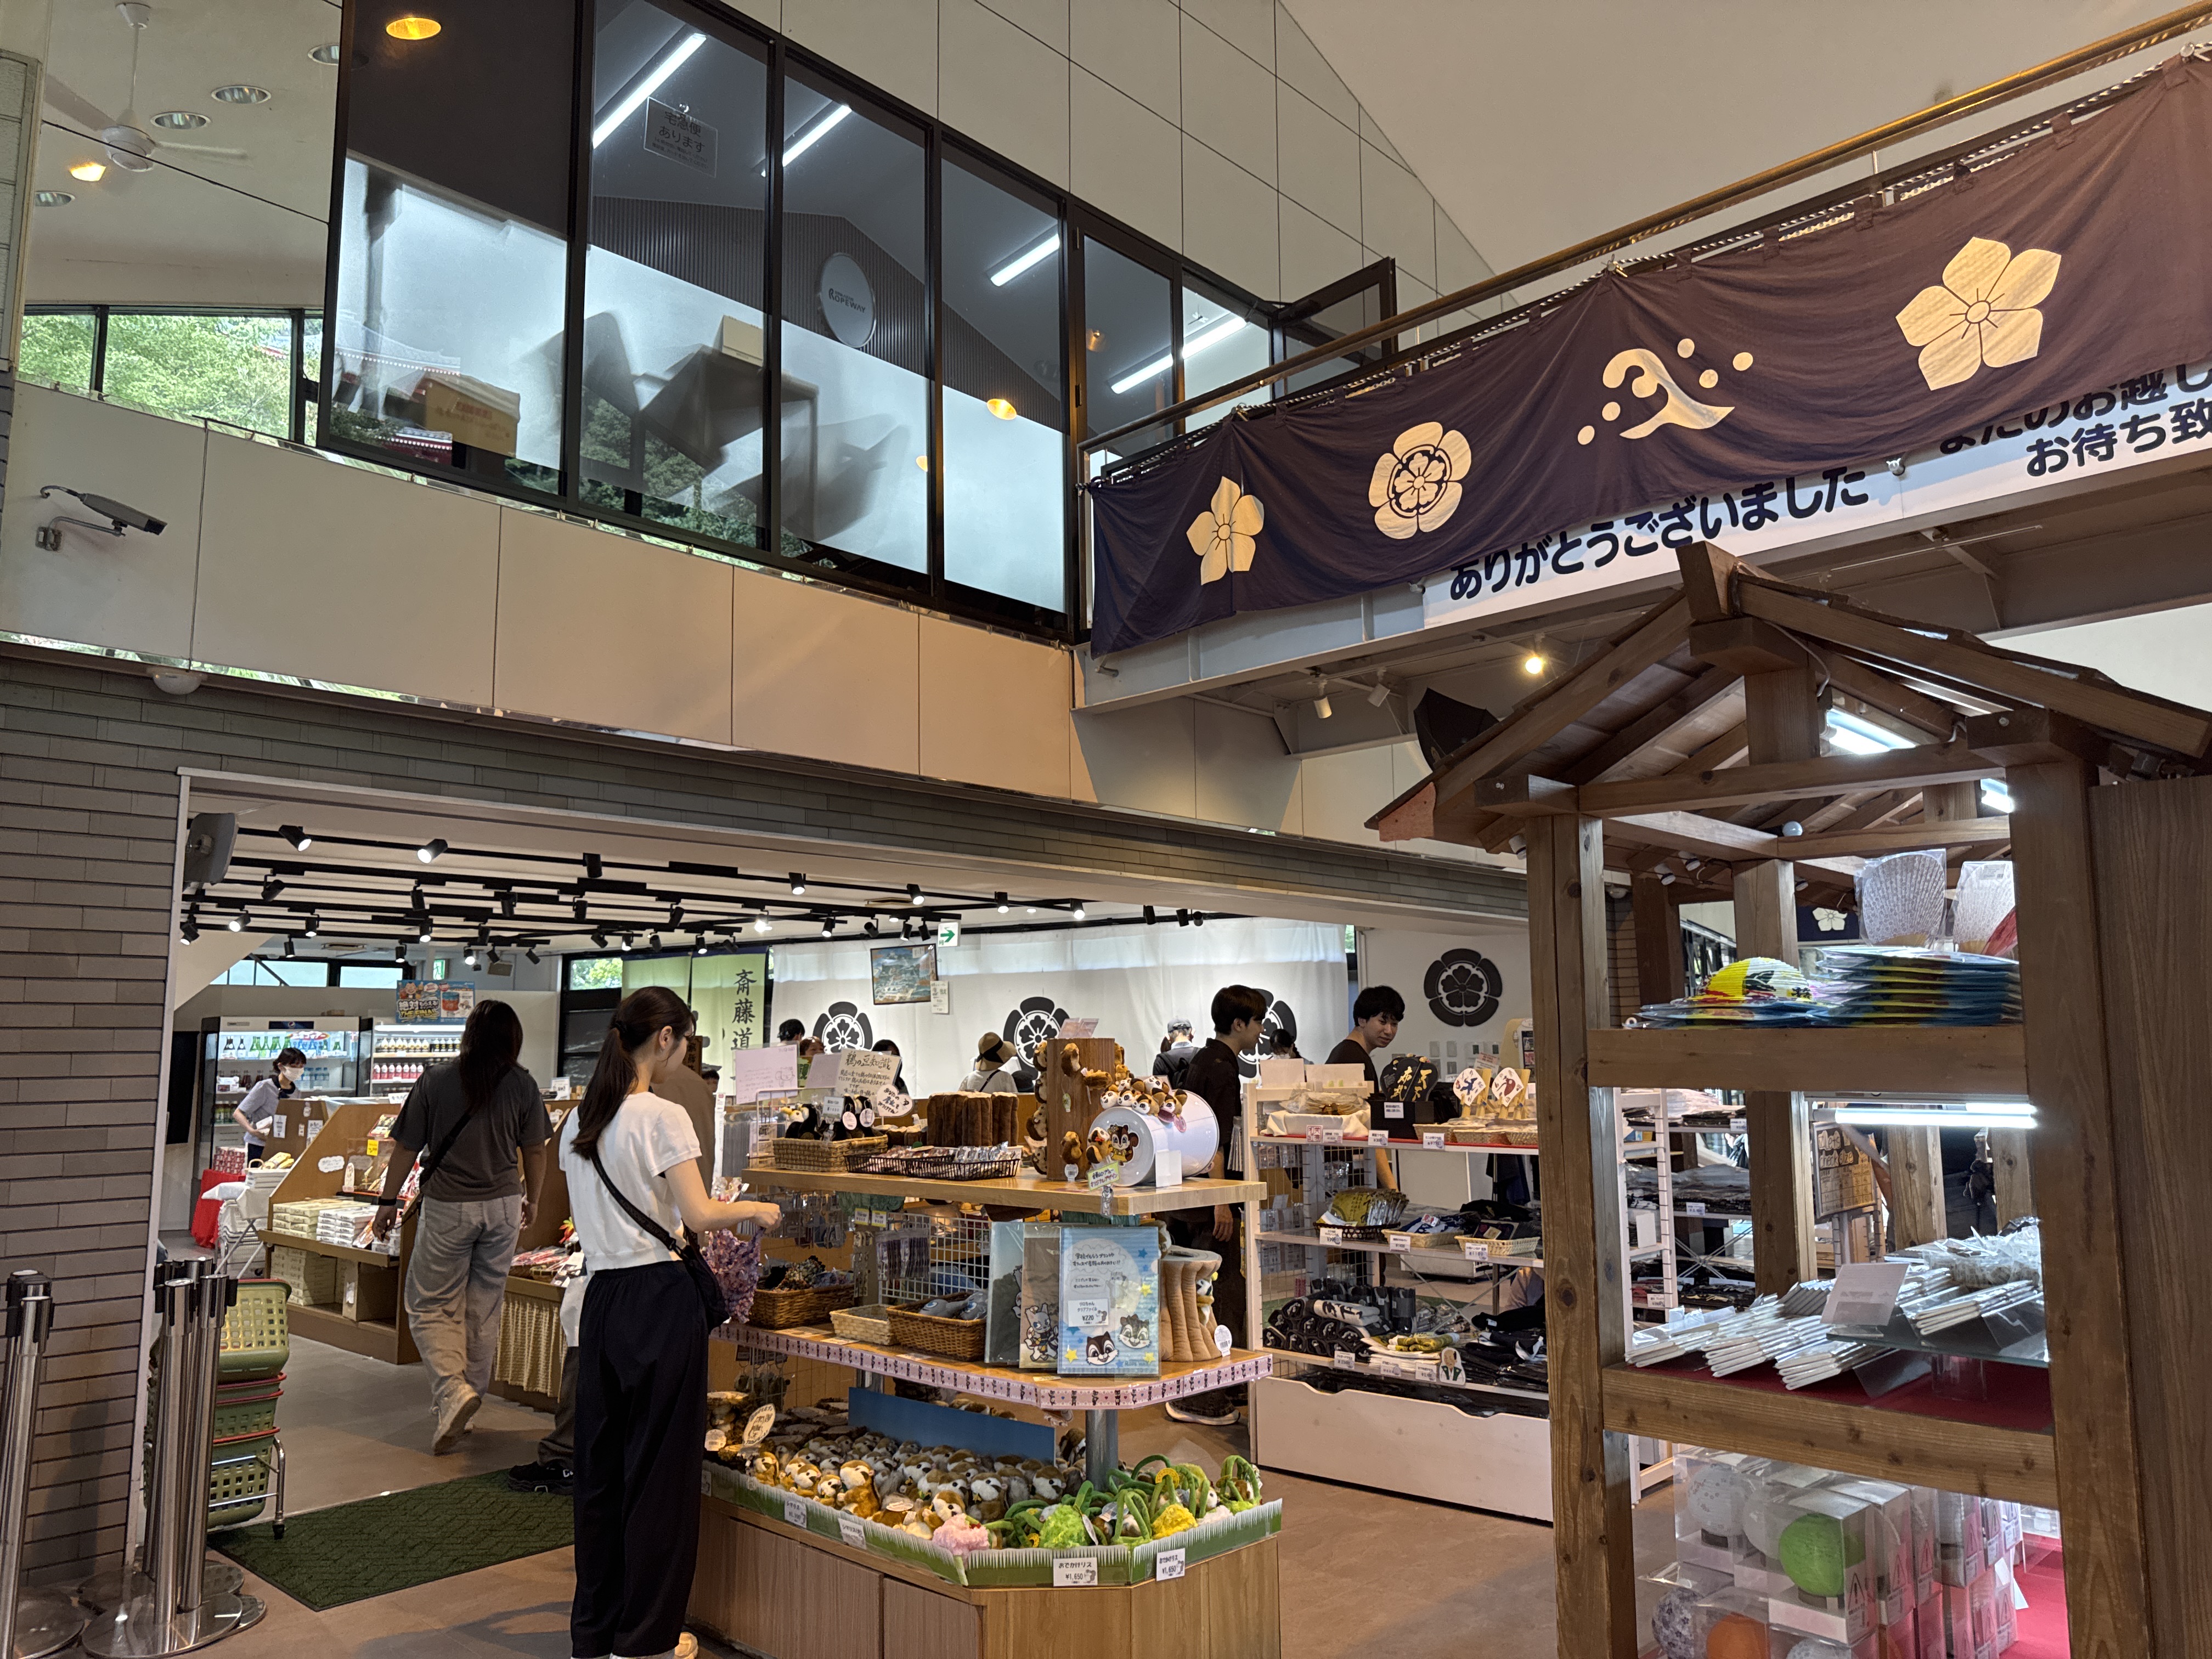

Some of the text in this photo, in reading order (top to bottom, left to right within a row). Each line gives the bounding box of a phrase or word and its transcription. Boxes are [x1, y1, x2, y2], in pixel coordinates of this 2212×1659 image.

[664, 111, 702, 137] 宅急便
[659, 126, 705, 153] あります
[828, 288, 865, 313] ROPEWAY
[2026, 398, 2212, 477] お待ち致
[1450, 466, 1869, 601] ありがとうございました
[1820, 1152, 1853, 1166] check size
[1159, 1554, 1178, 1564] おでかけリス
[1162, 1565, 1177, 1575] ¥1,650
[1065, 1573, 1083, 1581] ¥1,650
